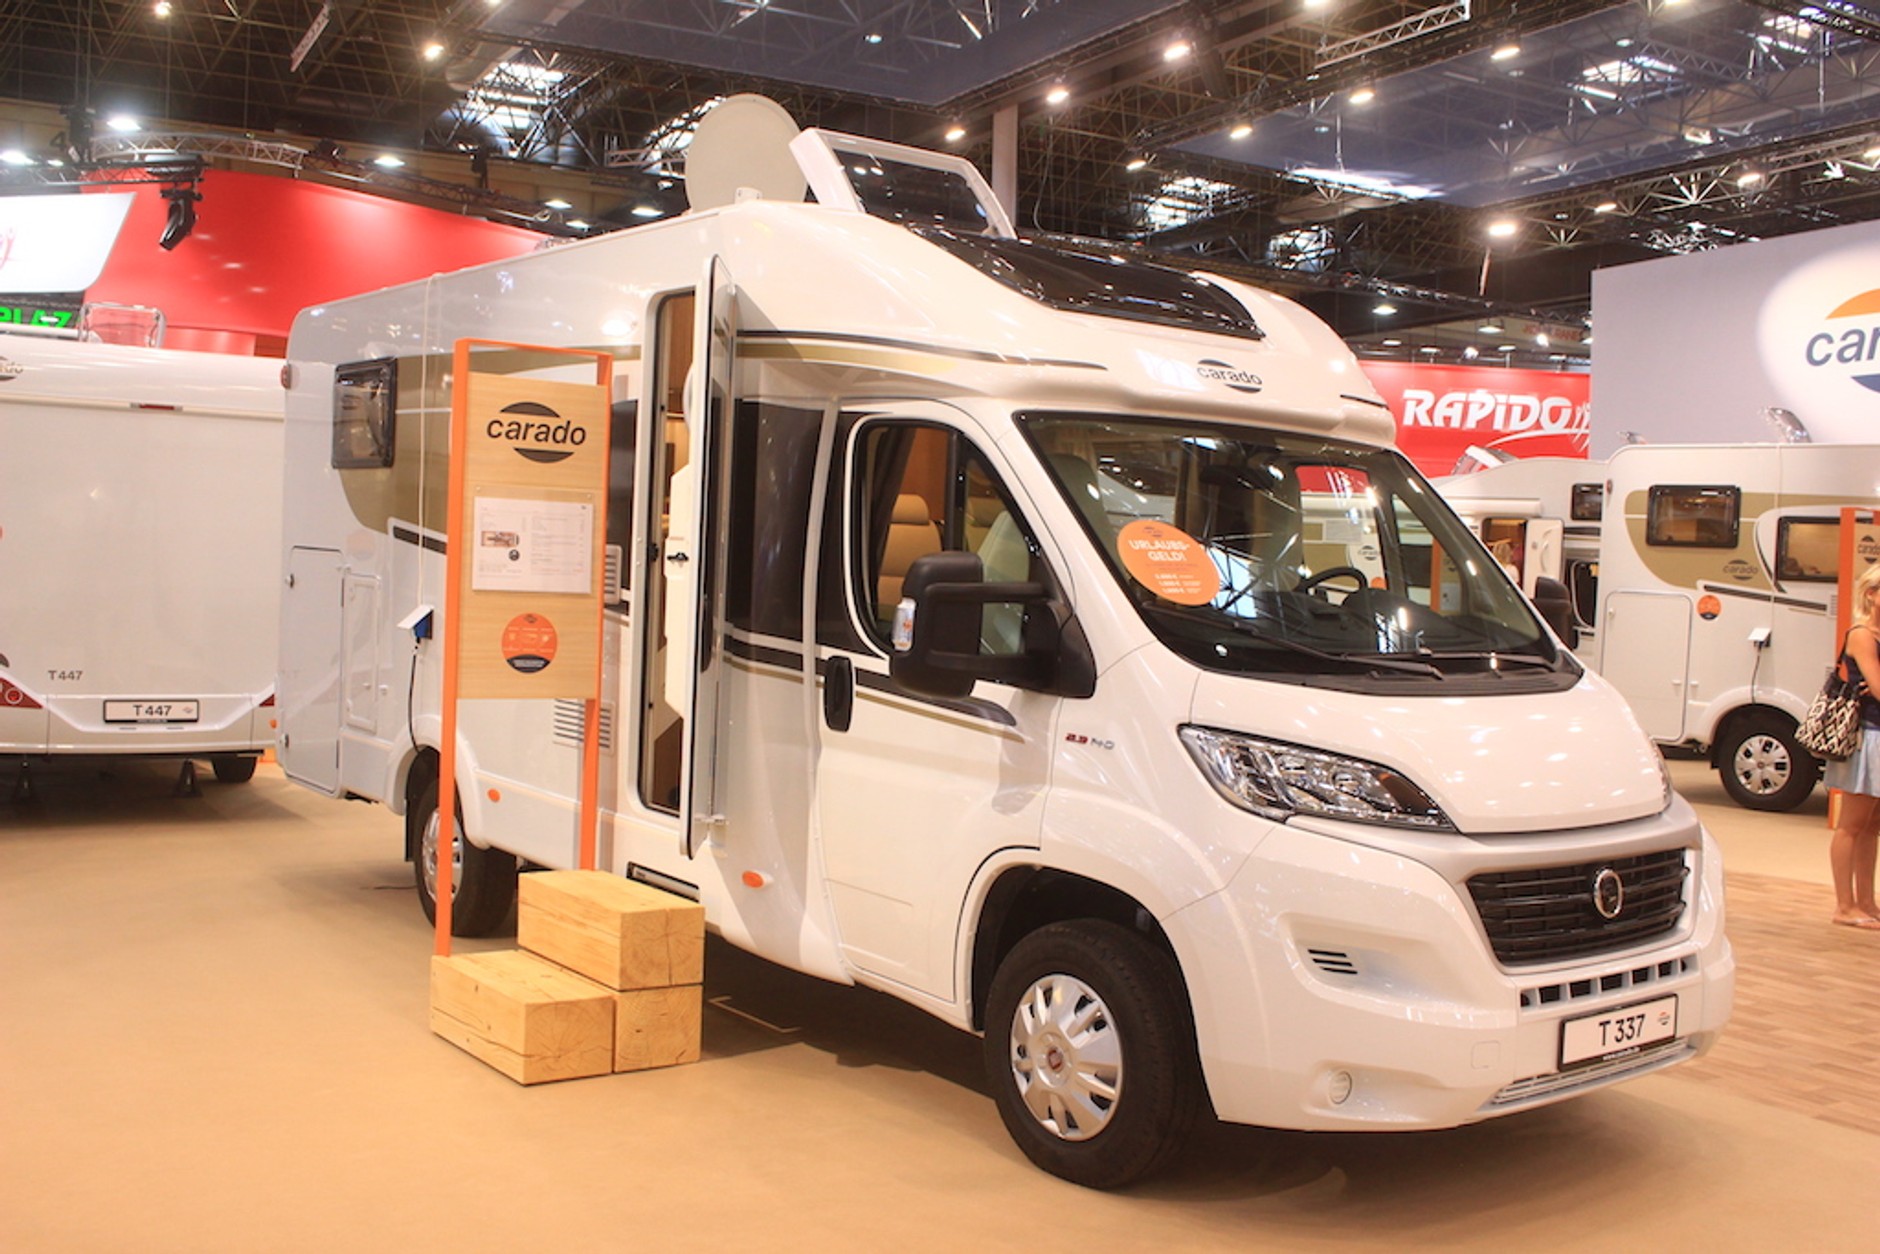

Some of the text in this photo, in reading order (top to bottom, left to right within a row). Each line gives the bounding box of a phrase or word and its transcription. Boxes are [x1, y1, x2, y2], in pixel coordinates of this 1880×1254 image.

[1197, 367, 1263, 385] carado
[1402, 388, 1572, 432] RAPIDO
[486, 419, 587, 446] carado
[1722, 563, 1759, 576] carado
[48, 670, 83, 681] T 447
[133, 705, 143, 716] T
[145, 705, 172, 716] 447
[1599, 1020, 1611, 1046] T
[1614, 1013, 1646, 1043] 337
